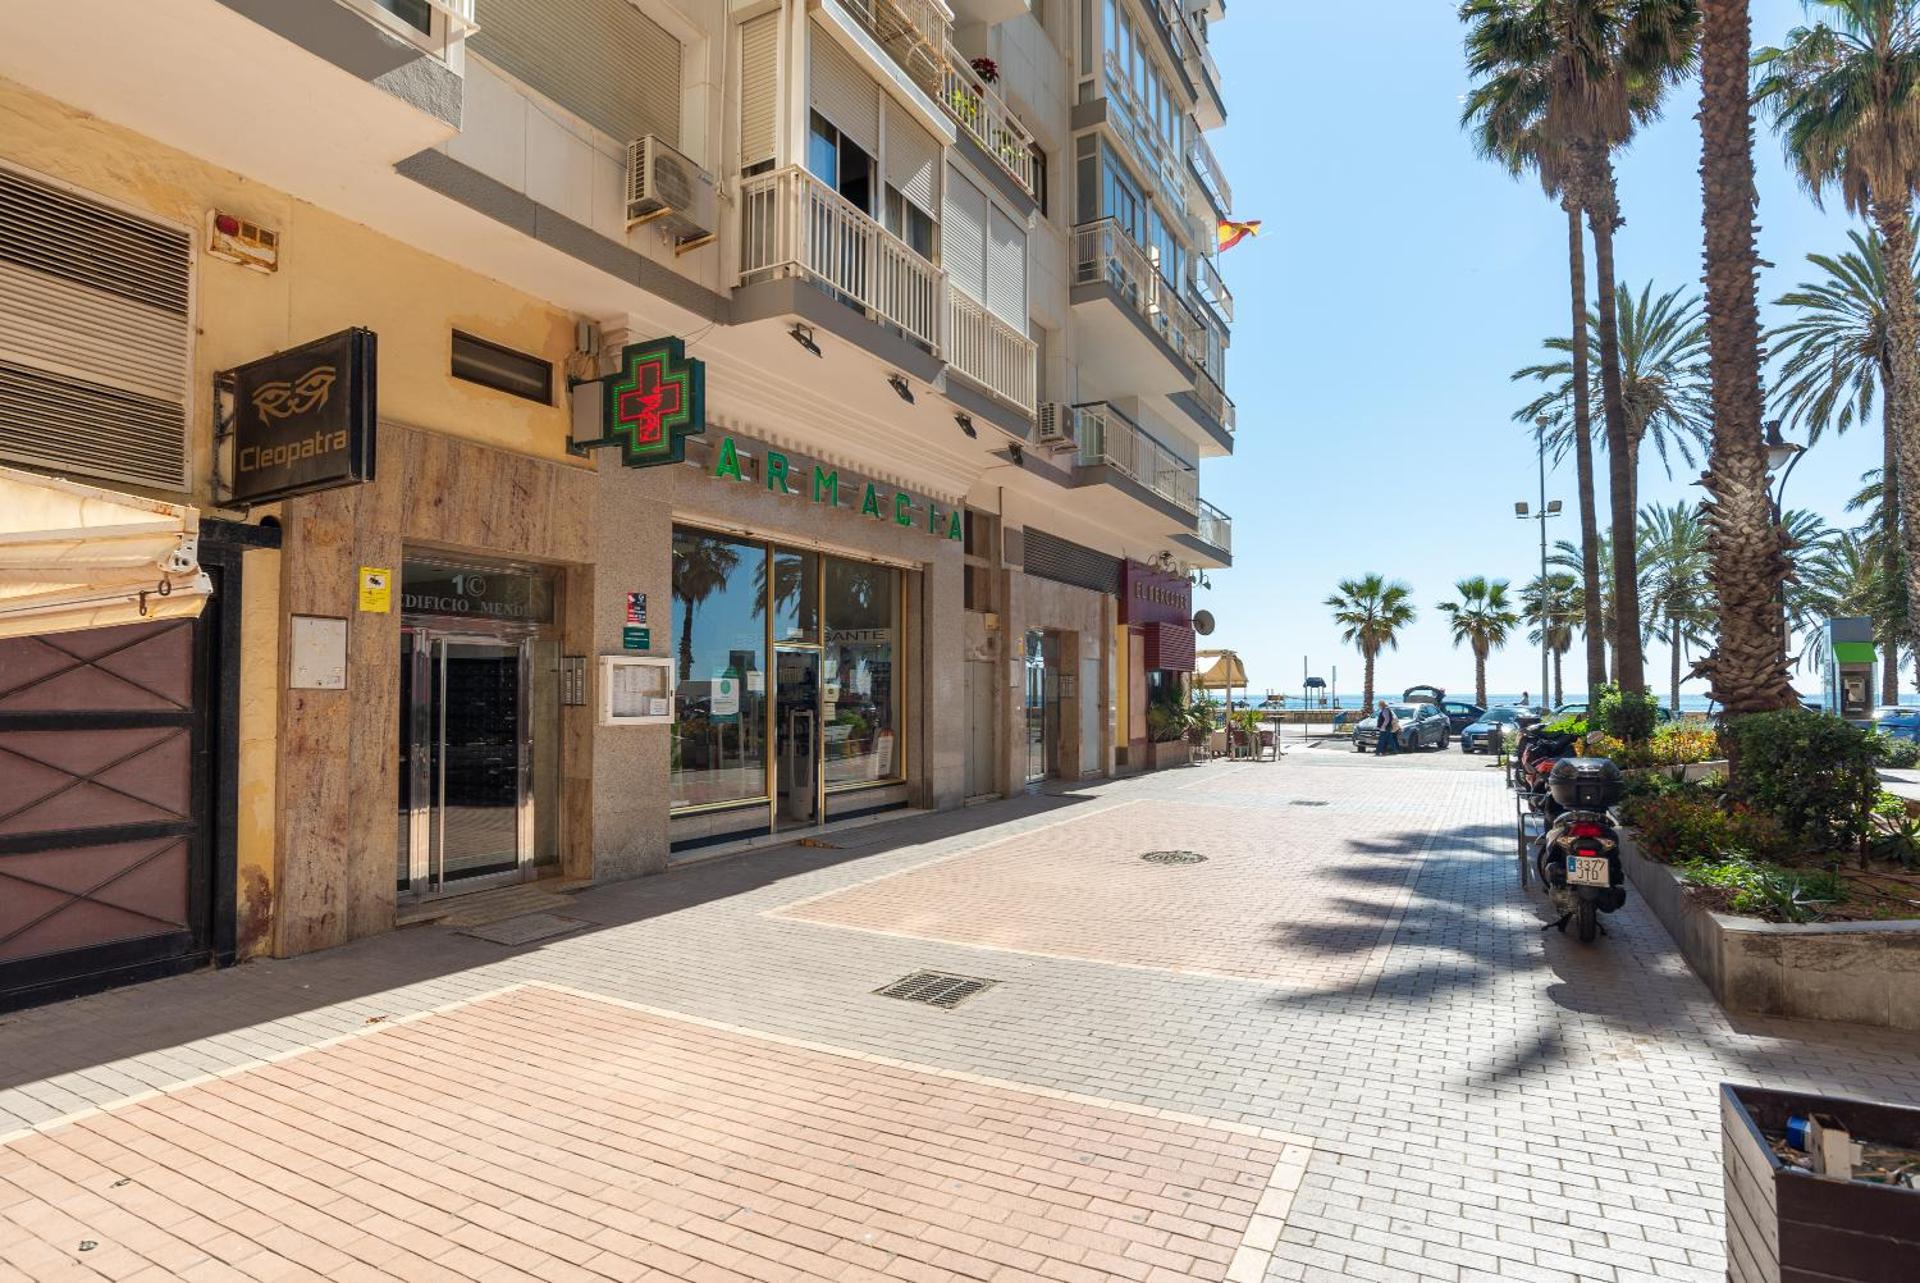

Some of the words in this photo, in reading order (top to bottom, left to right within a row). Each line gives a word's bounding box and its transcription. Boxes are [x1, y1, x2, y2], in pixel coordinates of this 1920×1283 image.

[239, 430, 348, 472] Cleopatra
[714, 435, 963, 542] ARMACIA
[1576, 859, 1606, 871] 3377
